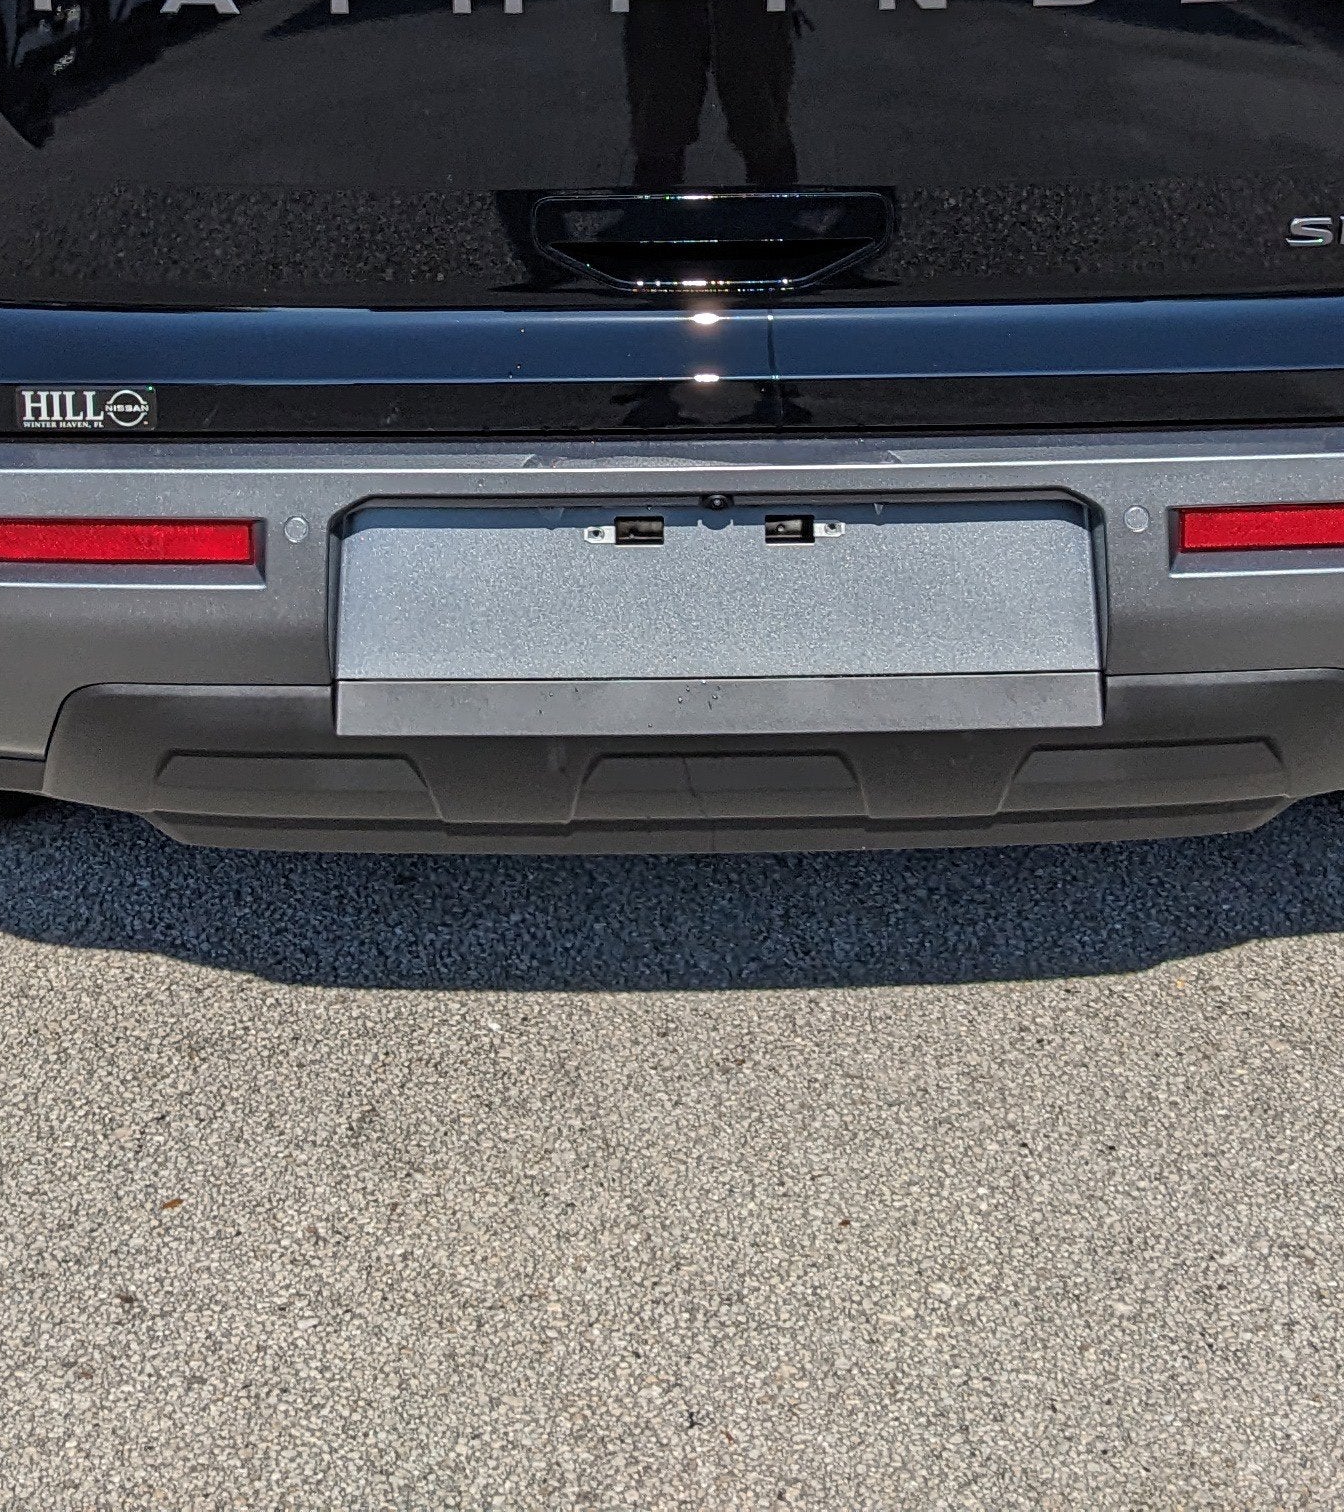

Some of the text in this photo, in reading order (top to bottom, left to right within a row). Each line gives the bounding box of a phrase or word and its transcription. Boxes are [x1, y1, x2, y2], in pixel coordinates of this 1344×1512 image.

[22, 391, 104, 420] HILL
[105, 404, 149, 412] NISSAN
[59, 421, 92, 429] HAVEN,
